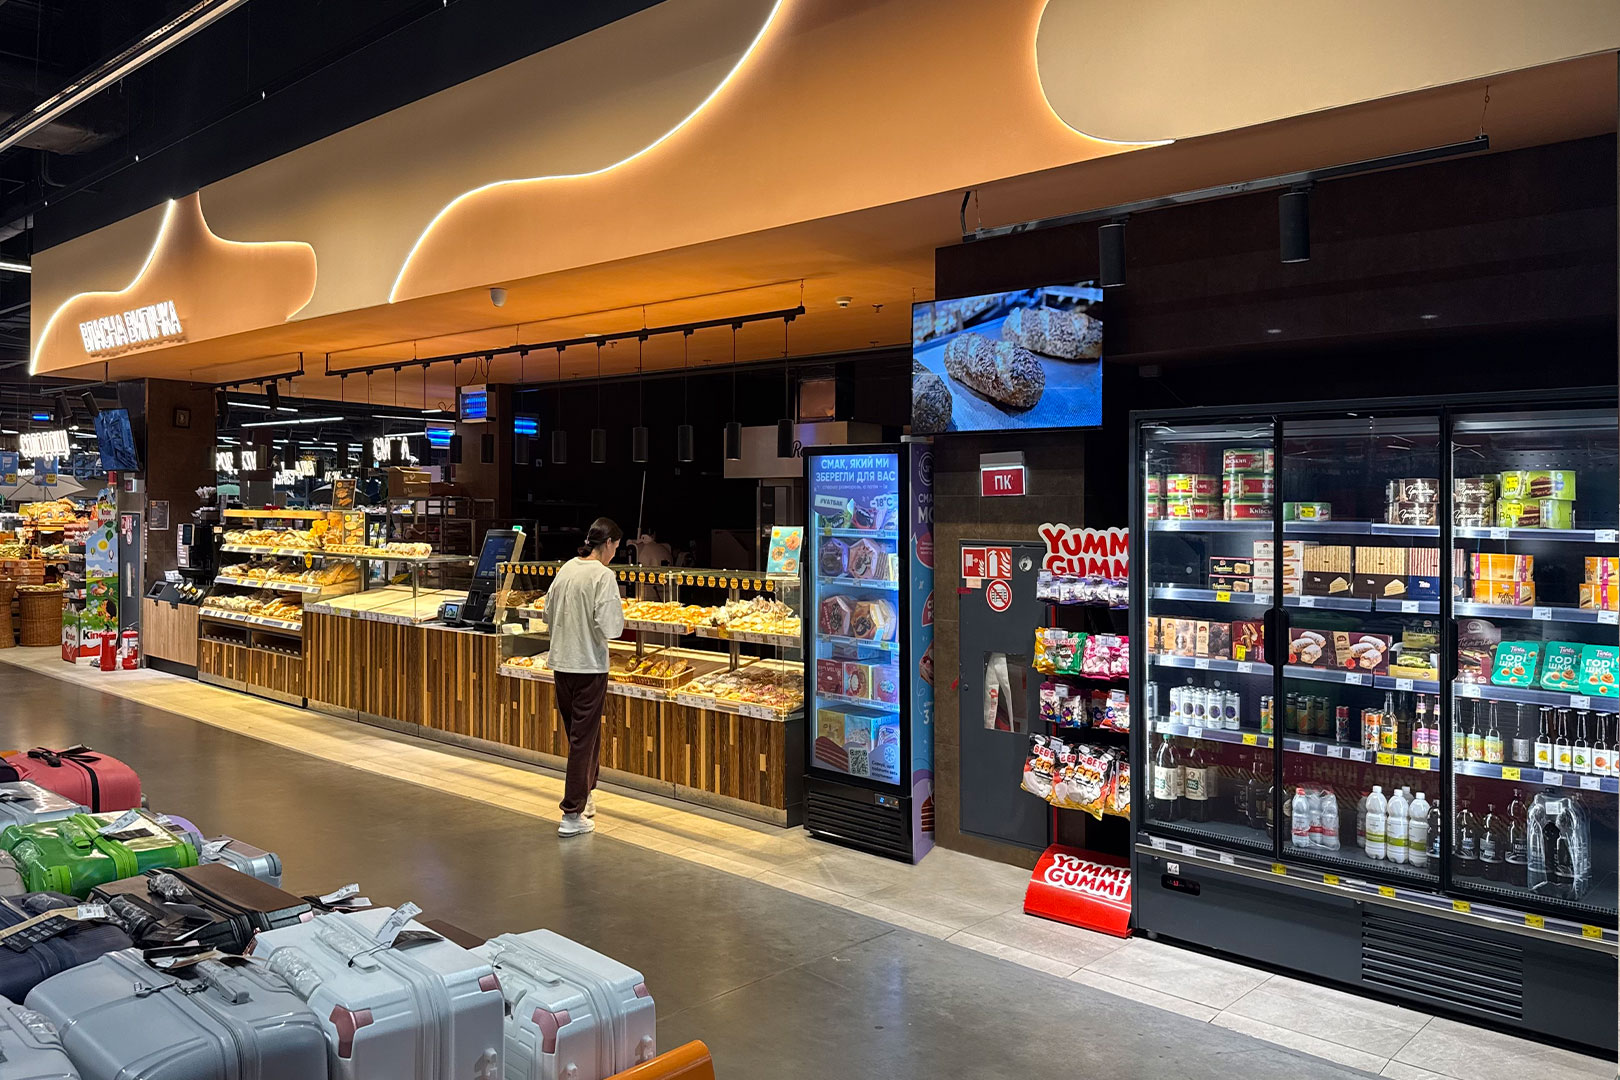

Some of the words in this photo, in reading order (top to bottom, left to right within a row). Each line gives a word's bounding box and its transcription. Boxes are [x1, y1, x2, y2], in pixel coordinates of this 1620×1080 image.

[80, 313, 130, 353] ВЛАСНА
[821, 458, 849, 470] СМАК,
[850, 456, 874, 469] ЯКИЙ
[875, 458, 890, 468] МИ
[816, 472, 855, 482] ЗБЕРЕГЛИ
[857, 471, 875, 483] ДЛЯ
[877, 471, 896, 481] ВАС
[994, 475, 1012, 490] ПК
[1042, 528, 1129, 558] YUMM
[1046, 554, 1129, 579] GUMM
[1500, 653, 1527, 663] горі
[1549, 654, 1577, 666] горі
[1586, 658, 1615, 669] горі
[1034, 744, 1055, 759] BEBE
